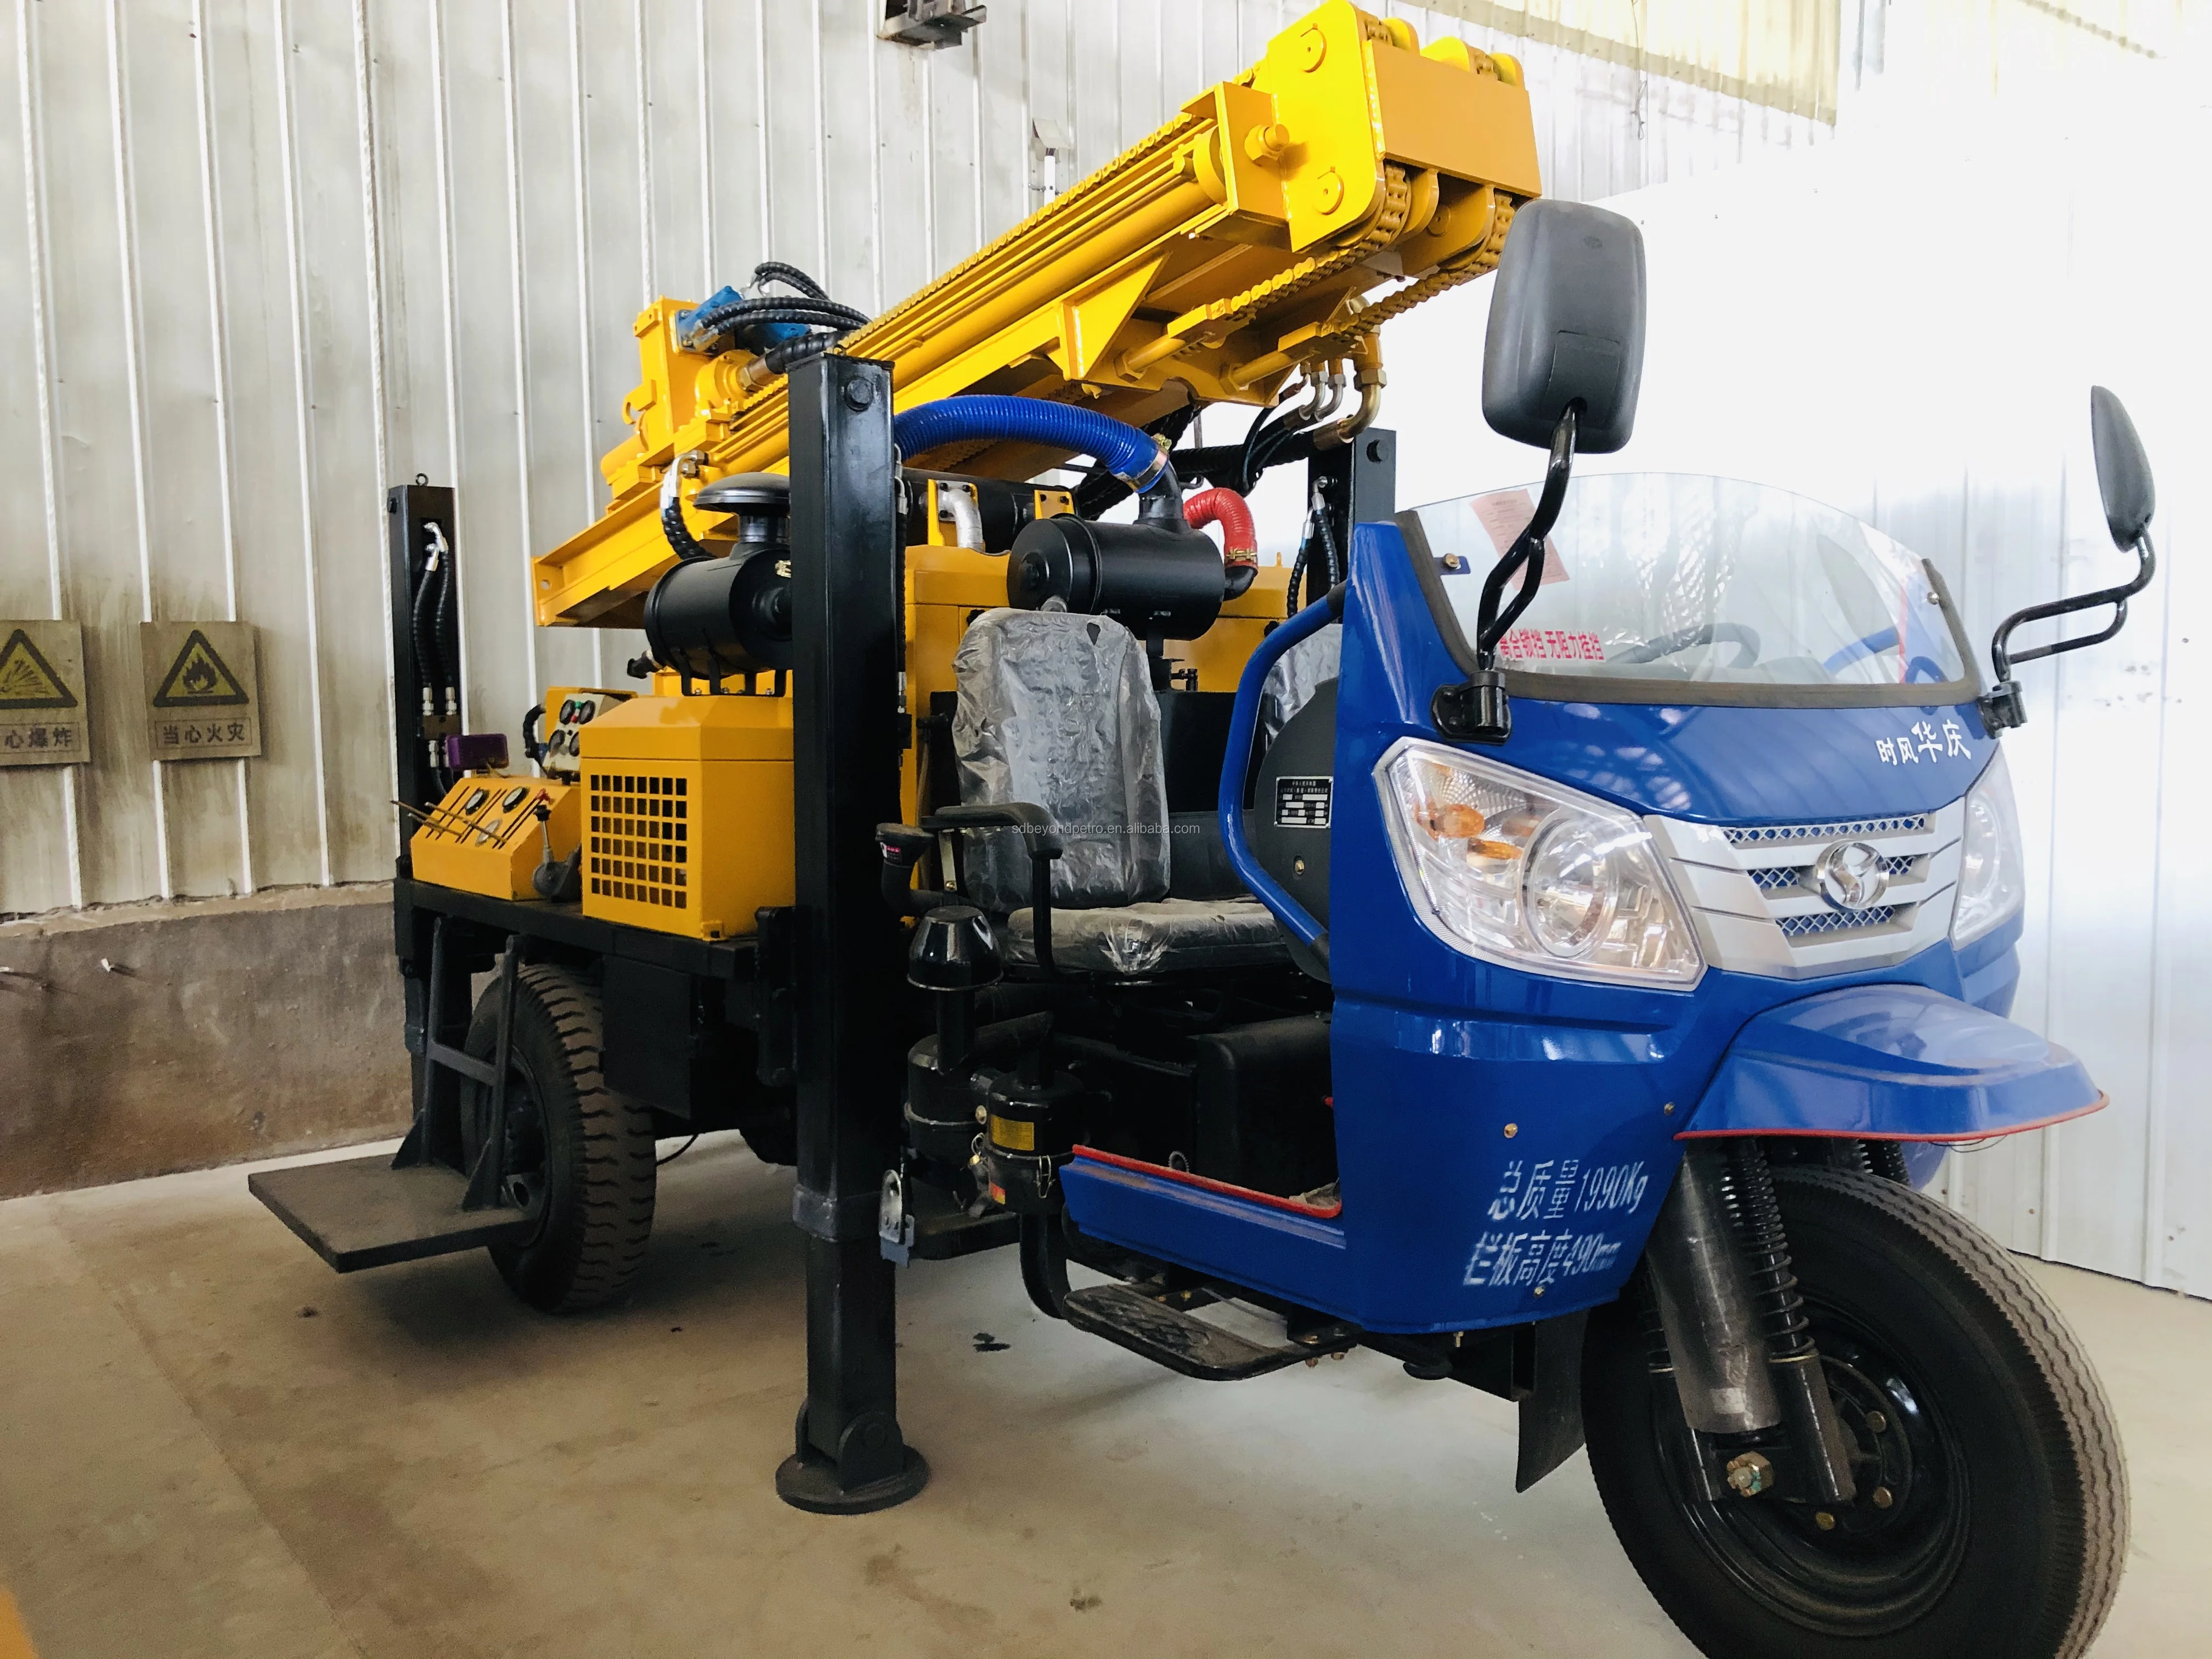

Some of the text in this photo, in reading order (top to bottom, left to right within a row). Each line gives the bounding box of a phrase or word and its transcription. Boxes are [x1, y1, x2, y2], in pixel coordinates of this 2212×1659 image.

[162, 722, 245, 745] 当心火灾
[1876, 719, 1972, 766] 时风华庆
